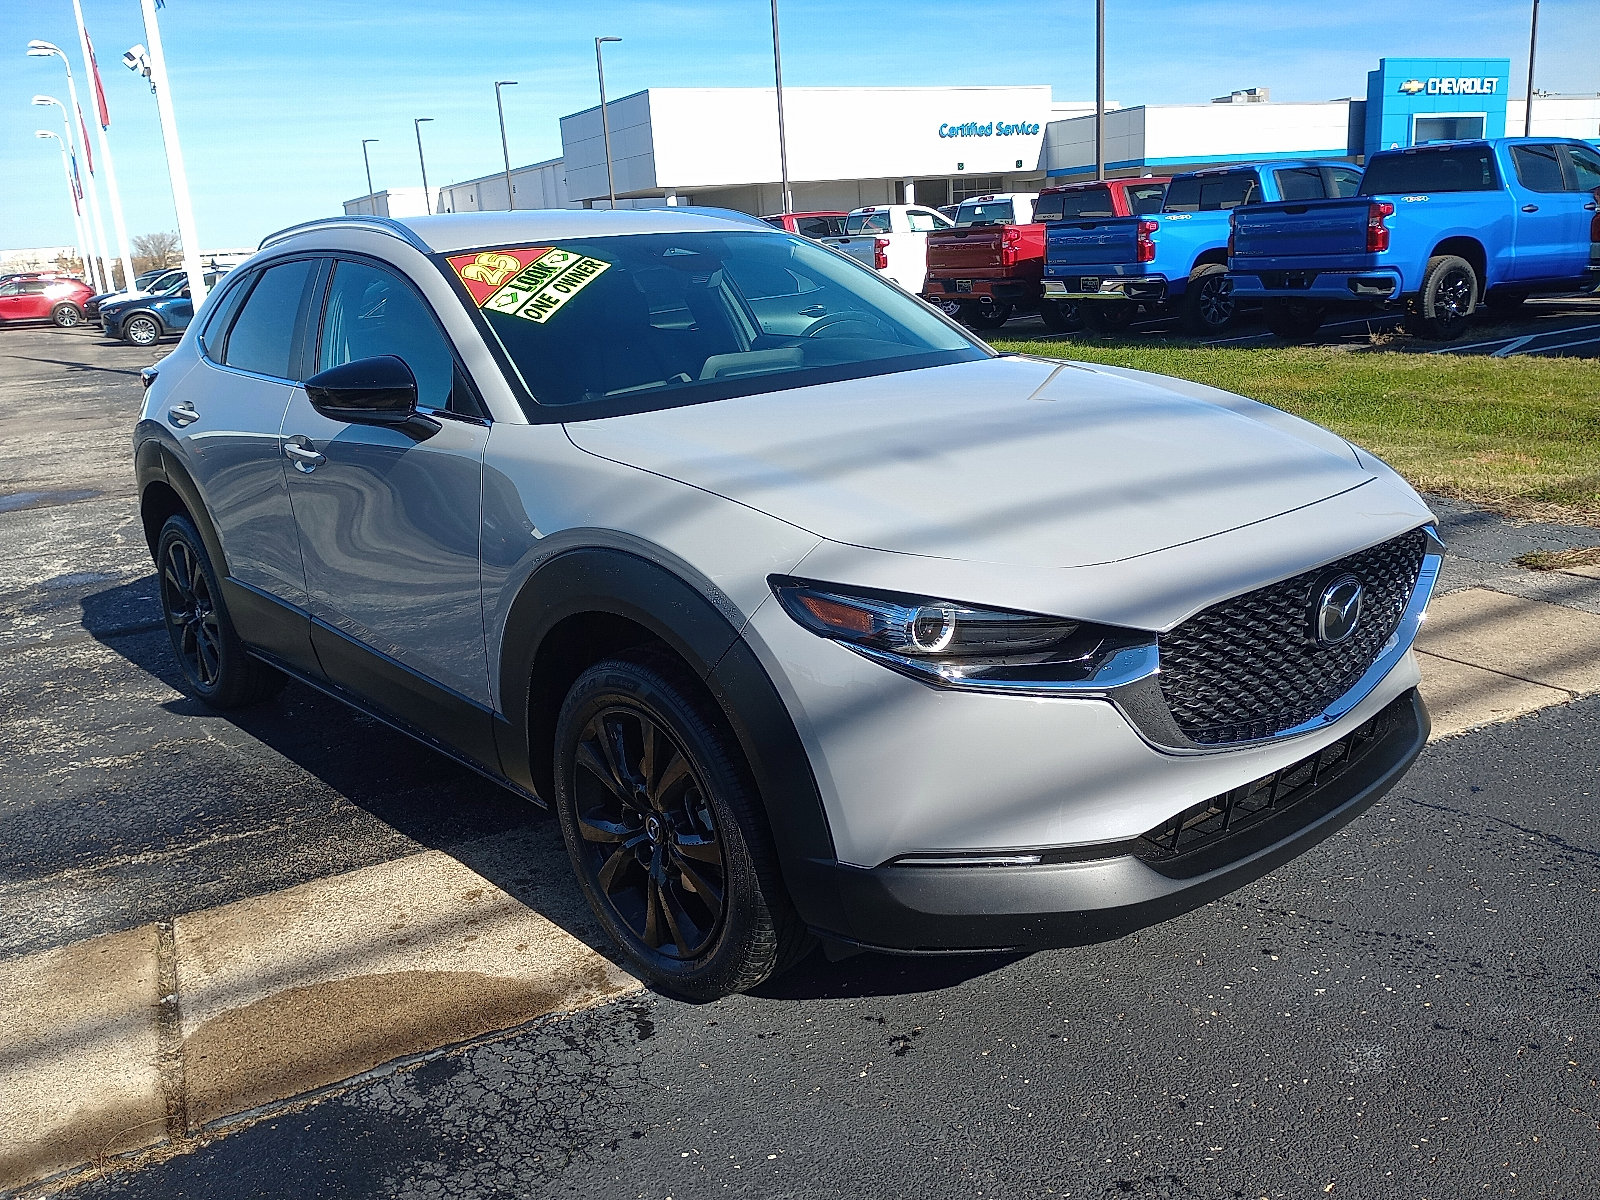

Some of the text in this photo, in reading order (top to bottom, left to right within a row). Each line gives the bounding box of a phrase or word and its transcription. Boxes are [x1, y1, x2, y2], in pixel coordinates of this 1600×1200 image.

[1427, 77, 1499, 95] CHEVROLET
[939, 121, 1040, 138] Certified Service
[460, 253, 521, 286] 25
[508, 261, 561, 292] LOOK
[524, 259, 605, 320] ONE OWNER
